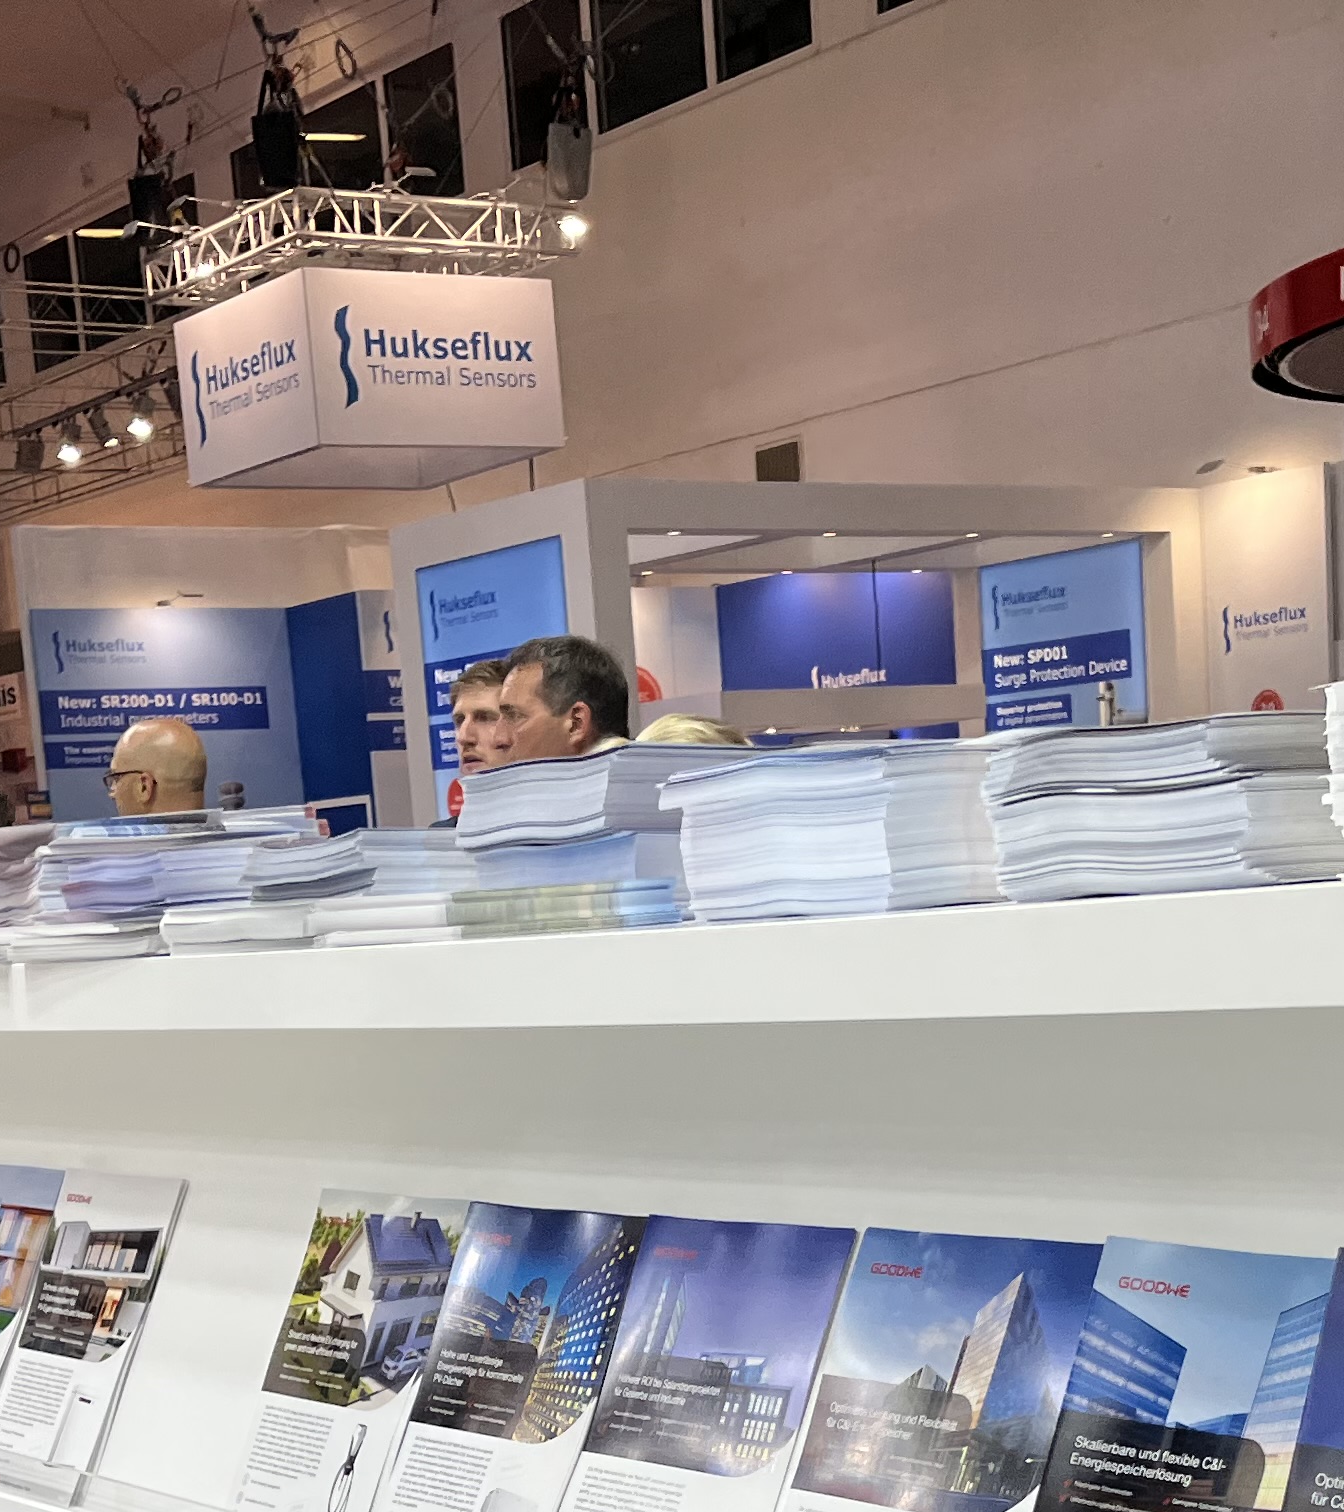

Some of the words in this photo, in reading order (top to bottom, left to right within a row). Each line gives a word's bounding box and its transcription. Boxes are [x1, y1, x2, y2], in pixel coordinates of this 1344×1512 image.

[364, 327, 533, 363] Hukseflux
[205, 338, 297, 396] Hukseflux
[367, 364, 452, 388] Thermal
[459, 366, 537, 390] Sensors
[209, 390, 254, 420] Thermal
[255, 373, 301, 405] Sensors
[1233, 606, 1307, 629] Hukseflux
[65, 639, 145, 653] Hukseflux
[993, 653, 1025, 669] New:
[1028, 645, 1069, 665] SPD01
[820, 667, 887, 689] Hukseflux
[994, 671, 1028, 690] Surge
[1030, 664, 1086, 684] Protection
[1089, 656, 1129, 677] Device
[58, 695, 96, 709] New:
[101, 693, 173, 709] SR200-D1
[191, 691, 262, 707] SR100-D1
[60, 713, 125, 729] Industrial
[870, 1262, 923, 1279] GOODWE
[1118, 1274, 1191, 1299] GOODWE
[1074, 1436, 1137, 1459] Skalierbare
[1139, 1448, 1159, 1463] und
[1162, 1452, 1199, 1470] flexible
[1310, 1492, 1328, 1507] für
